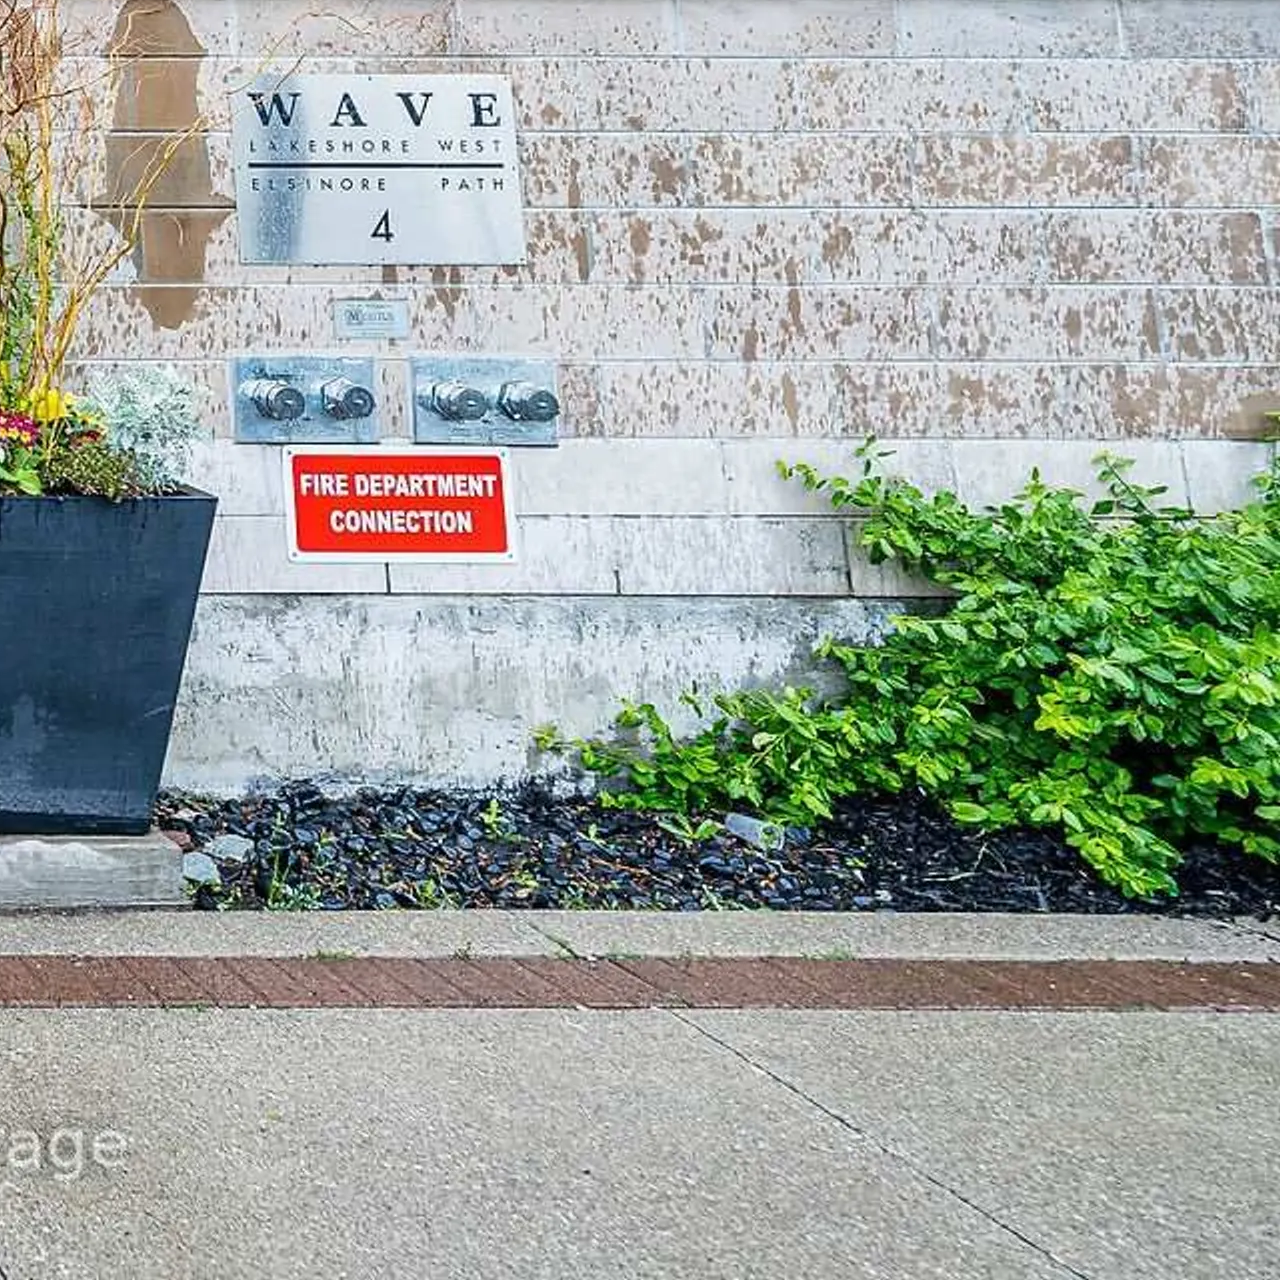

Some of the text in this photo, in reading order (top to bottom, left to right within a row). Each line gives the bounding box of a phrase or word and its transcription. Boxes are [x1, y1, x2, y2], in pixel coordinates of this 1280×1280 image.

[247, 92, 502, 128] WAVE
[249, 140, 503, 154] LAKESHORE WEST
[251, 178, 505, 192] ELSINORE PATH
[370, 208, 395, 243] 4
[300, 473, 498, 498] FIRE DEPARTMENT
[329, 510, 474, 534] CONNECTION
